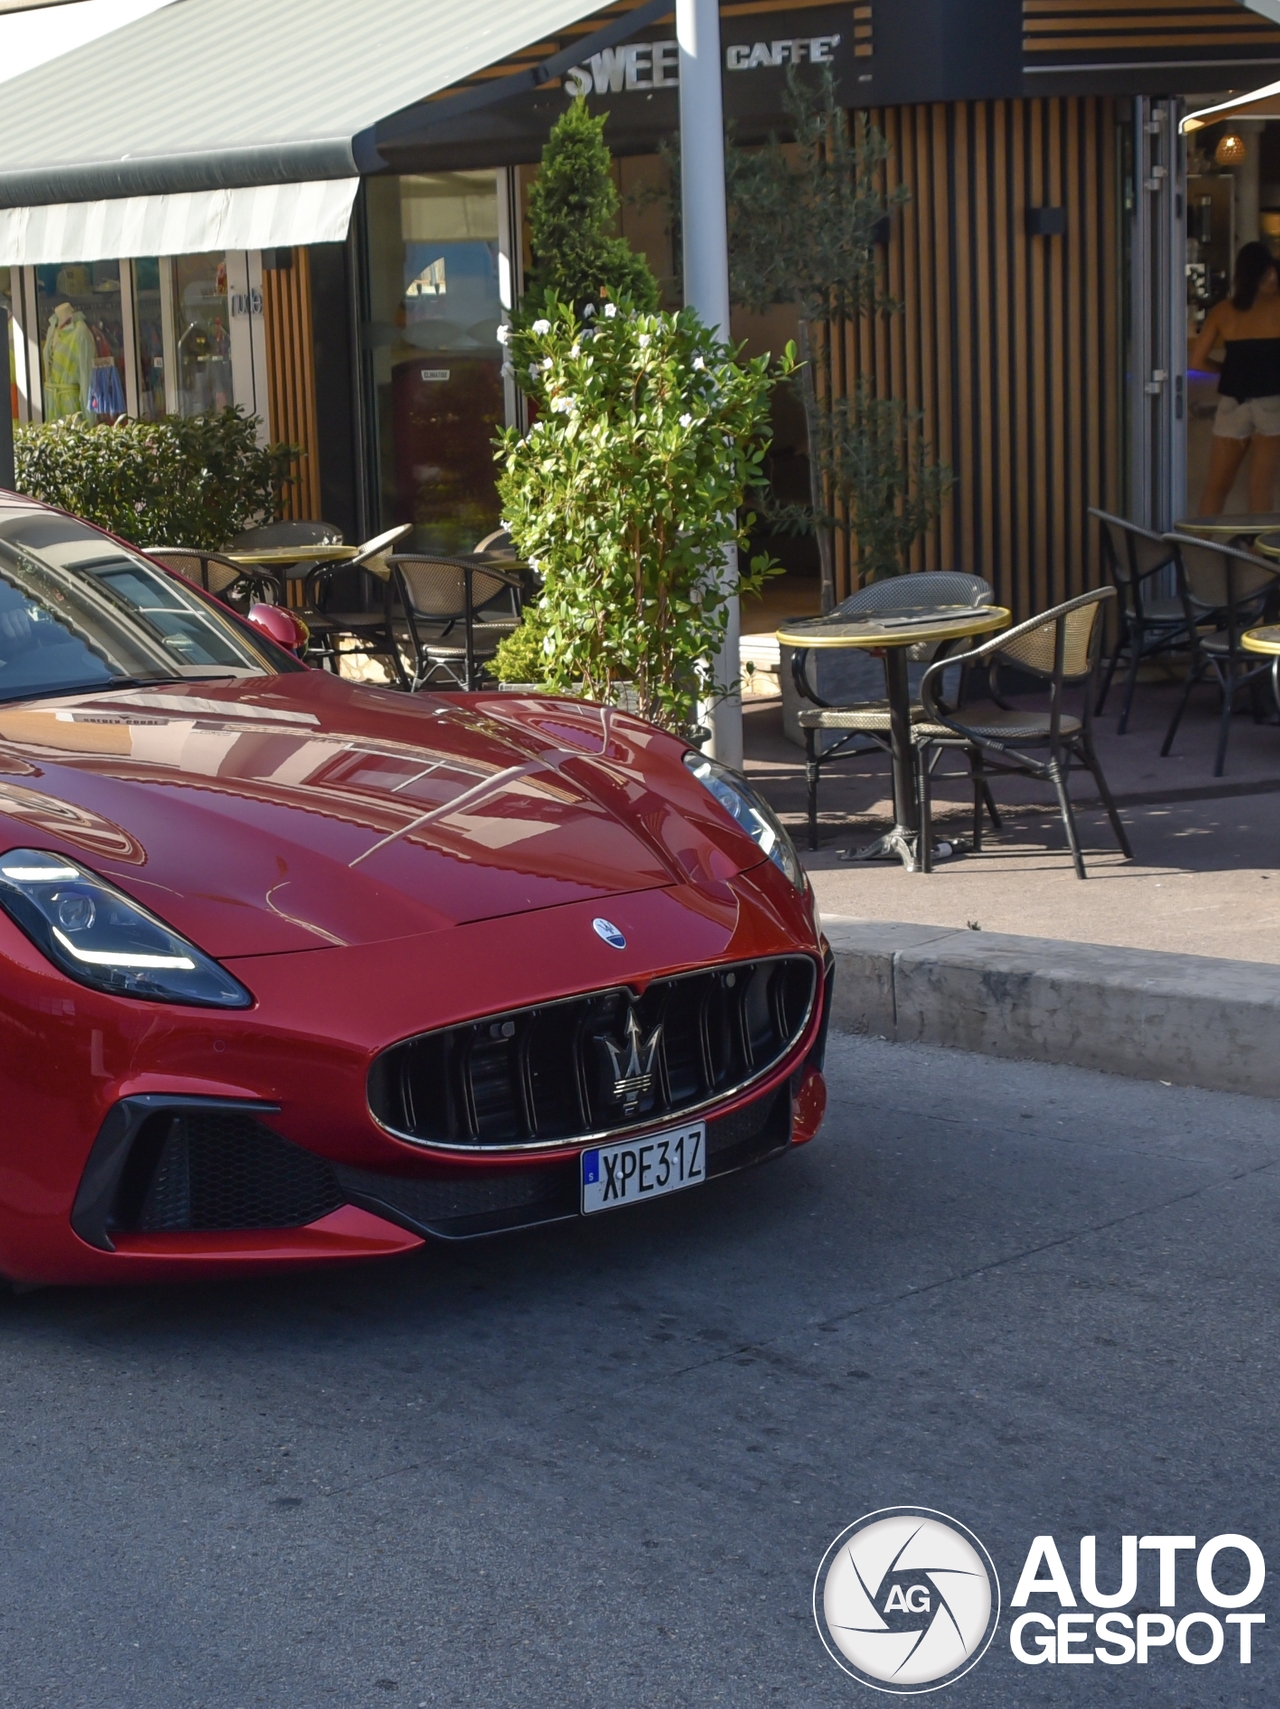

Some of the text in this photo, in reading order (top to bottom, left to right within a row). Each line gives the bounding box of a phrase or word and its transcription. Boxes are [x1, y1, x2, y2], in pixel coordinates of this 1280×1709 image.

[565, 40, 679, 97] SWEE
[588, 1173, 594, 1181] S
[602, 1131, 702, 1202] XPE31Z
